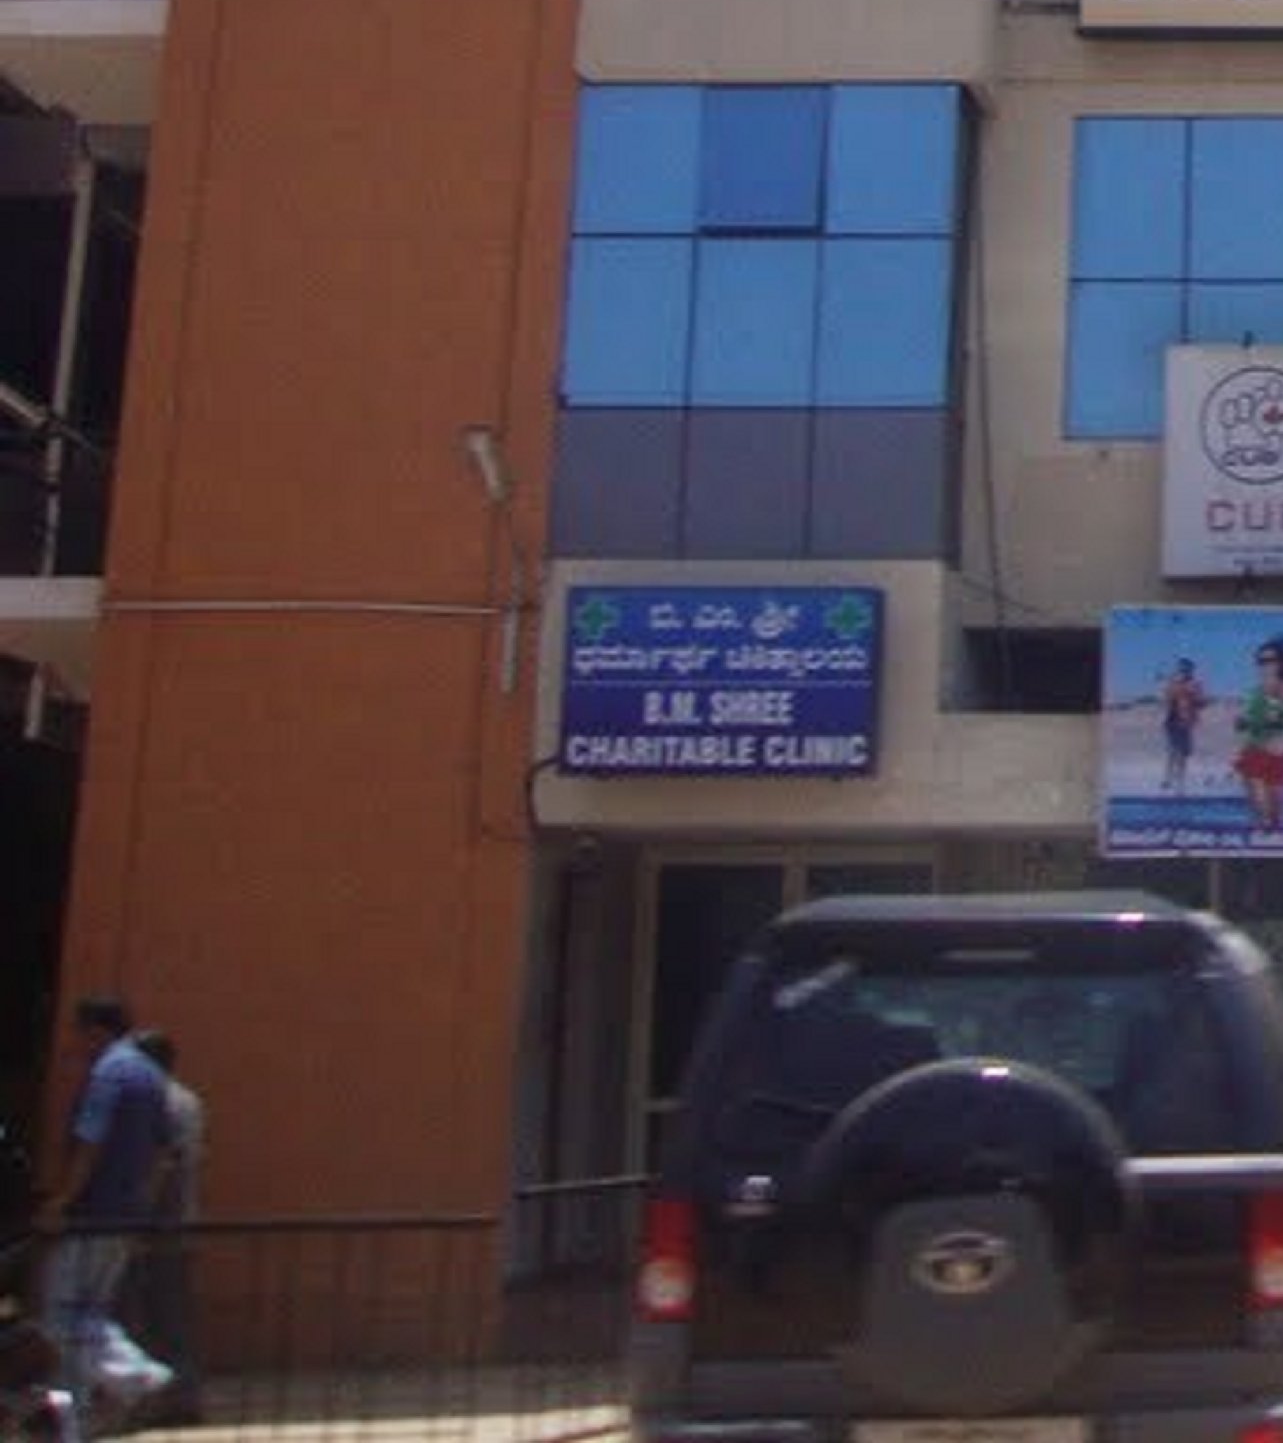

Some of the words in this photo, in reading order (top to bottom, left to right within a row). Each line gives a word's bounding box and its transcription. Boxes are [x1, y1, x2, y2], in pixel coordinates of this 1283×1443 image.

[643, 691, 702, 725] B.M.
[709, 691, 796, 725] SHREE
[566, 735, 757, 766] CHARITABLE
[762, 736, 869, 766] CLINIC
